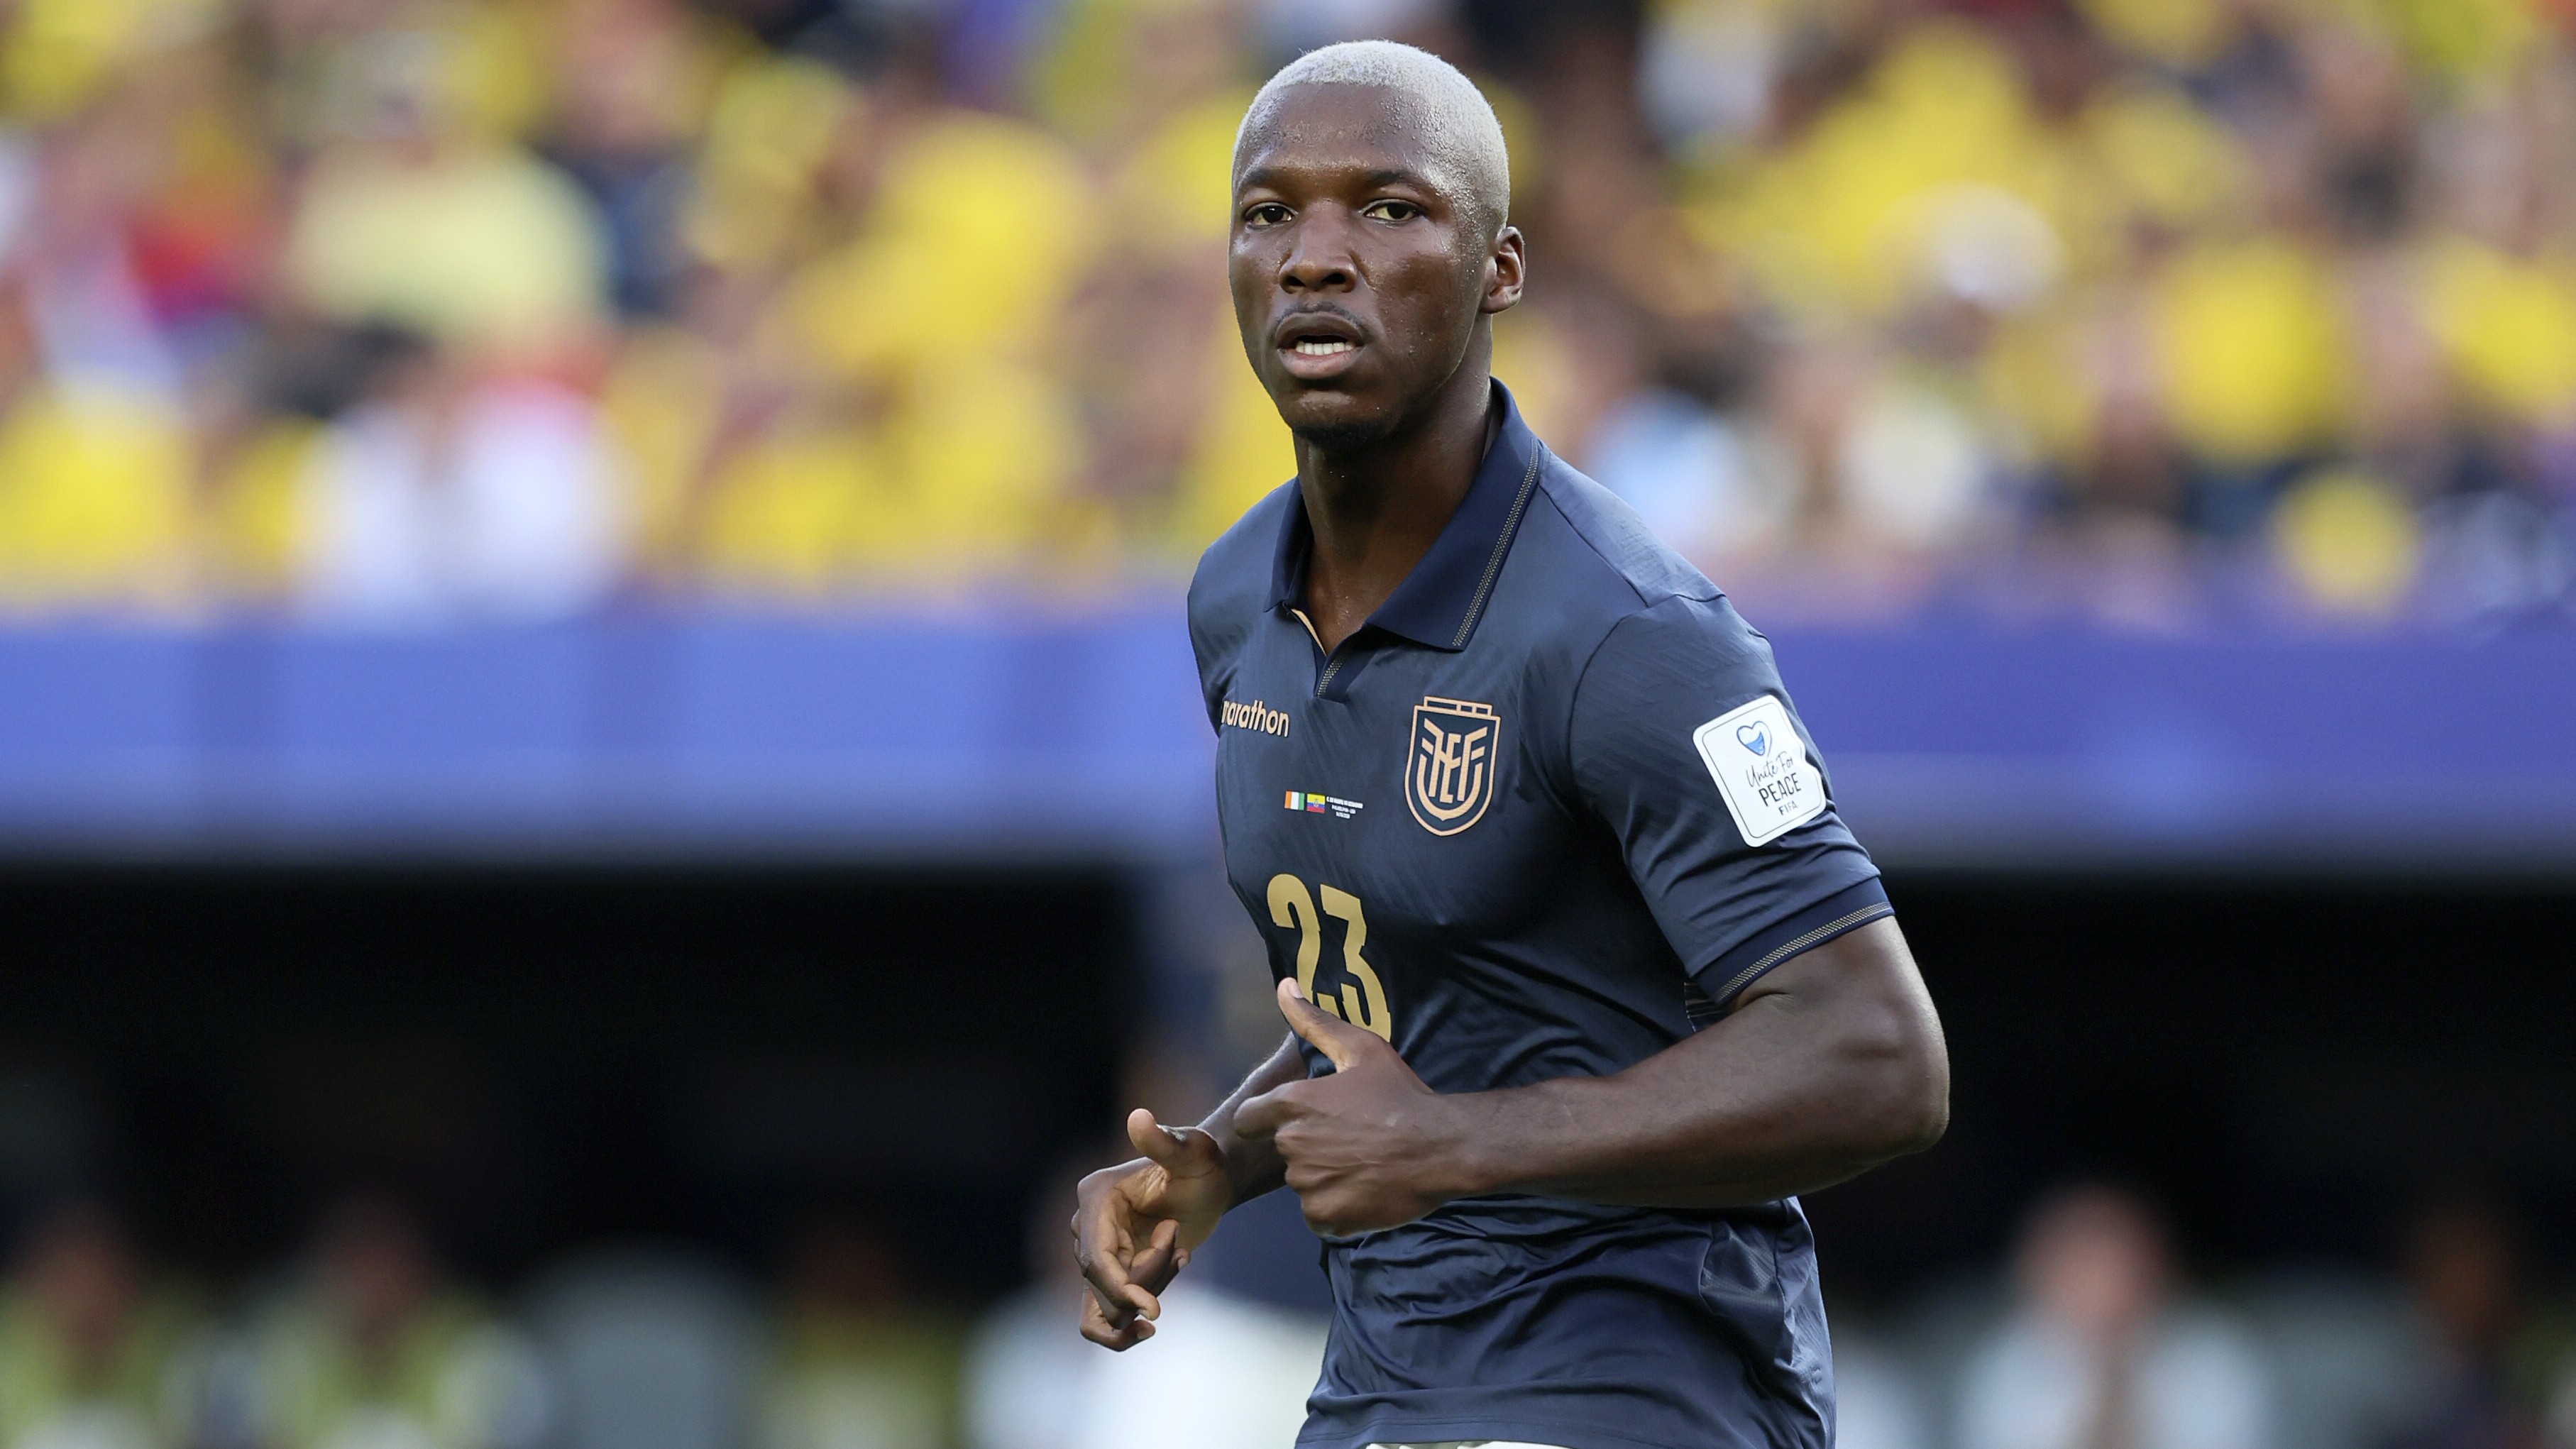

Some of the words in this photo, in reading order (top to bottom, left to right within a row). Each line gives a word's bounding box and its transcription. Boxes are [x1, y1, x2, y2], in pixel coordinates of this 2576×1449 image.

[1746, 761, 1777, 787] Unite
[1776, 751, 1794, 773] For
[1758, 773, 1801, 806] PEACE
[1778, 801, 1798, 815] FIFA
[1266, 873, 1392, 1043] 23
